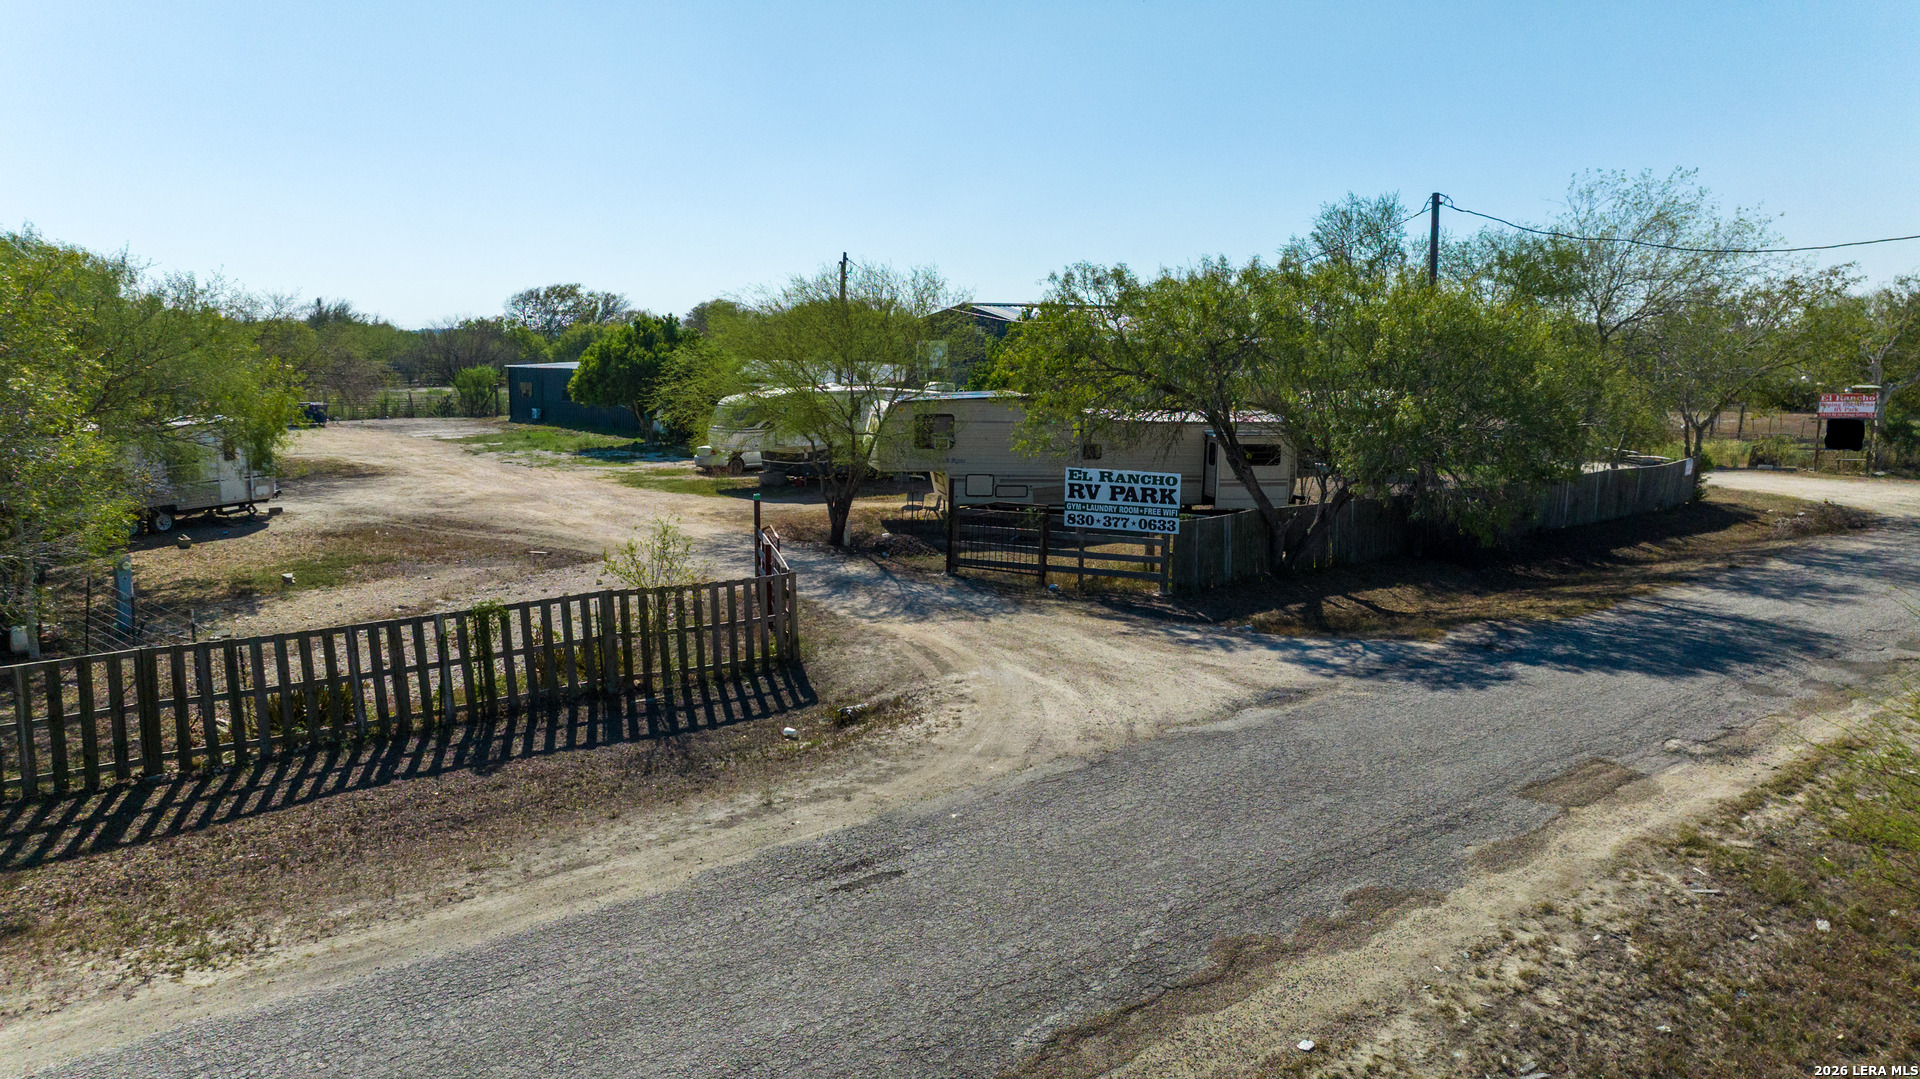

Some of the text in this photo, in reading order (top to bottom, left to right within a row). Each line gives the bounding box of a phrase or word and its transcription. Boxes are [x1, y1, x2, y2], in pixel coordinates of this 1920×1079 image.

[1068, 469, 1178, 487] EL RANCHO
[1067, 483, 1177, 505] RV PARK
[1066, 502, 1178, 517] GYM LAUNDRY ROOM FREE WIFI
[1066, 513, 1177, 532] 830 377 0633
